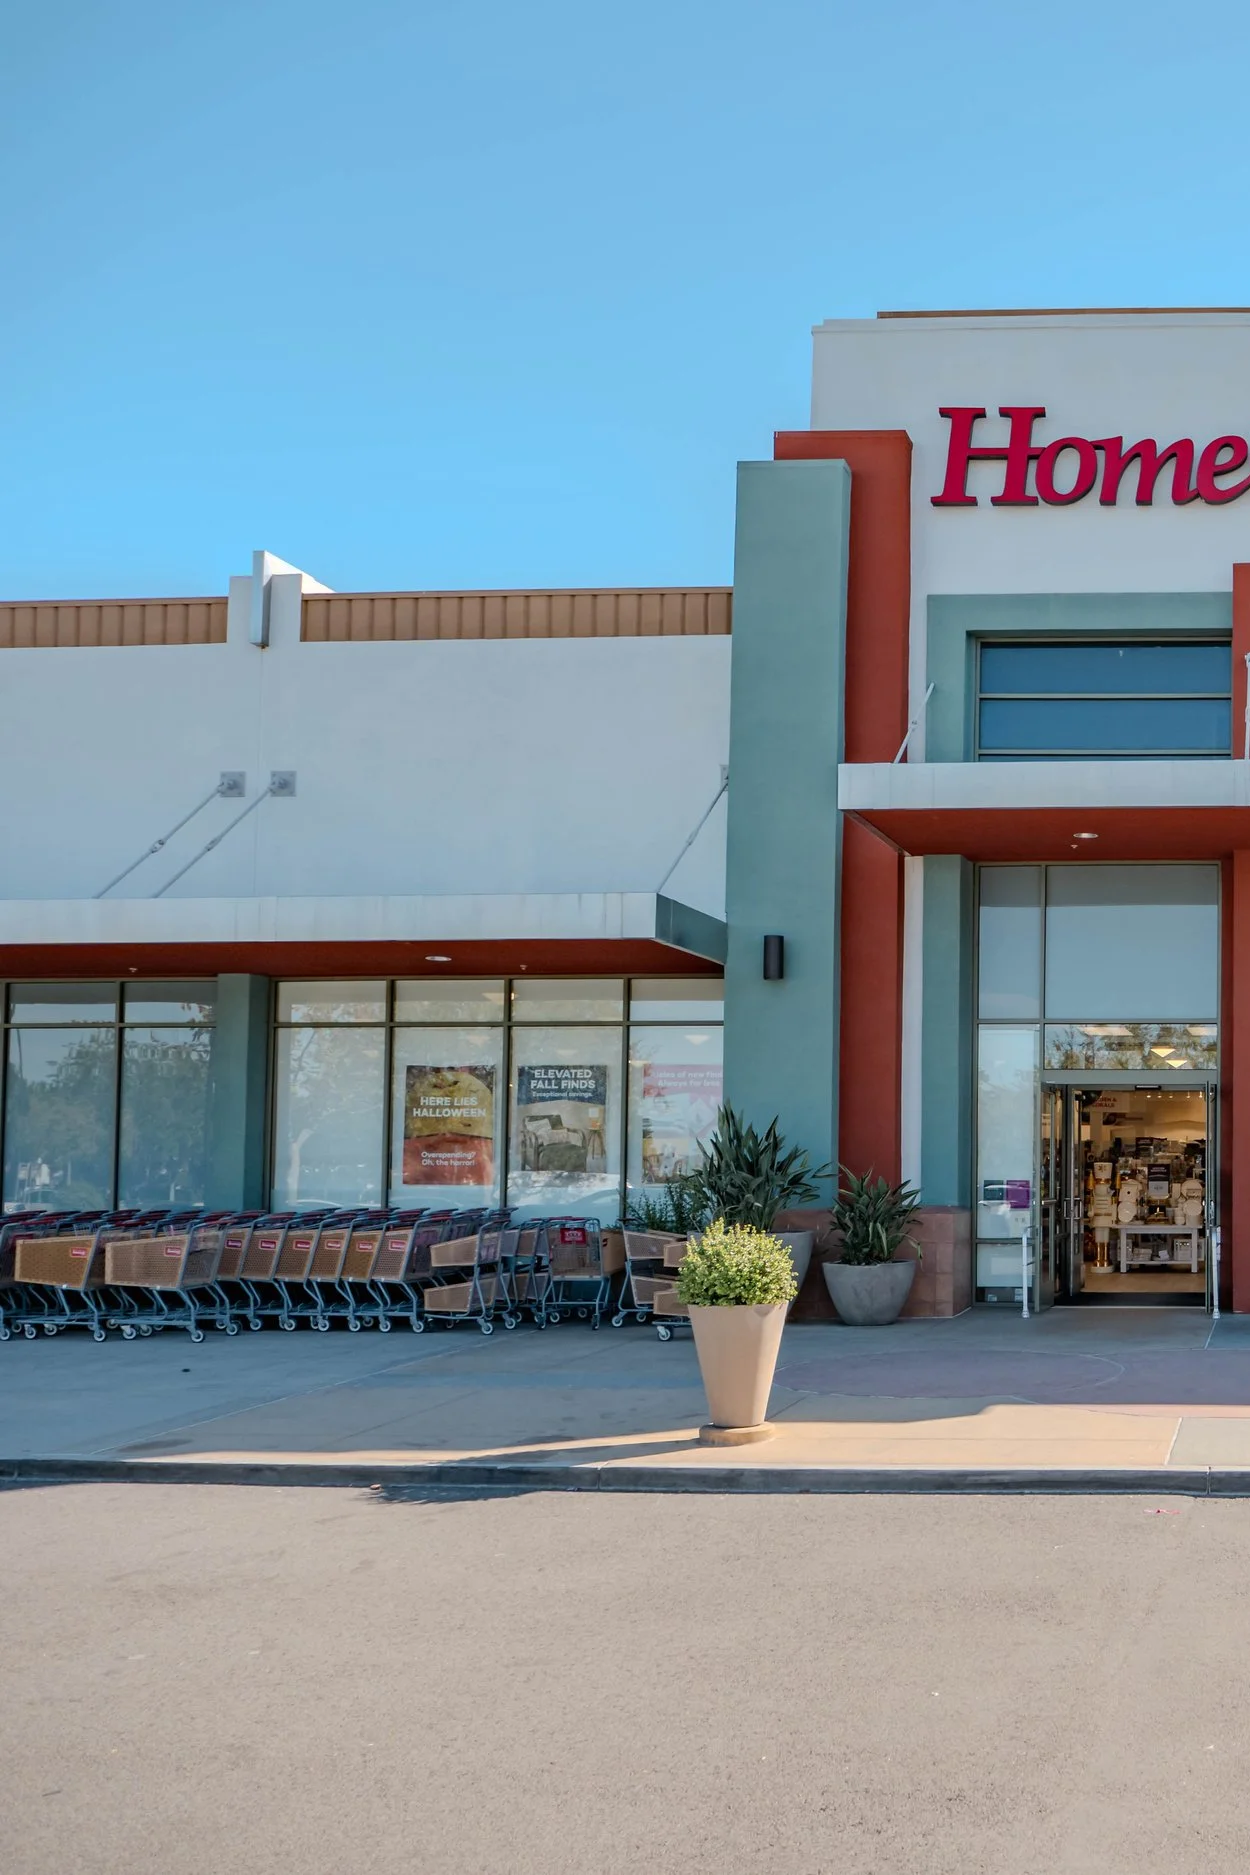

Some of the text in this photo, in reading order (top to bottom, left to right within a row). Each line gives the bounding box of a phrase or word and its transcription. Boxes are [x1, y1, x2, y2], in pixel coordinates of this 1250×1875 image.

[534, 1069, 592, 1078] ELEVATED
[531, 1080, 596, 1089] FALL FINDS
[420, 1097, 478, 1106] HERE LIES
[413, 1108, 486, 1117] HALLOWEEN
[421, 1152, 476, 1160] Overspending?
